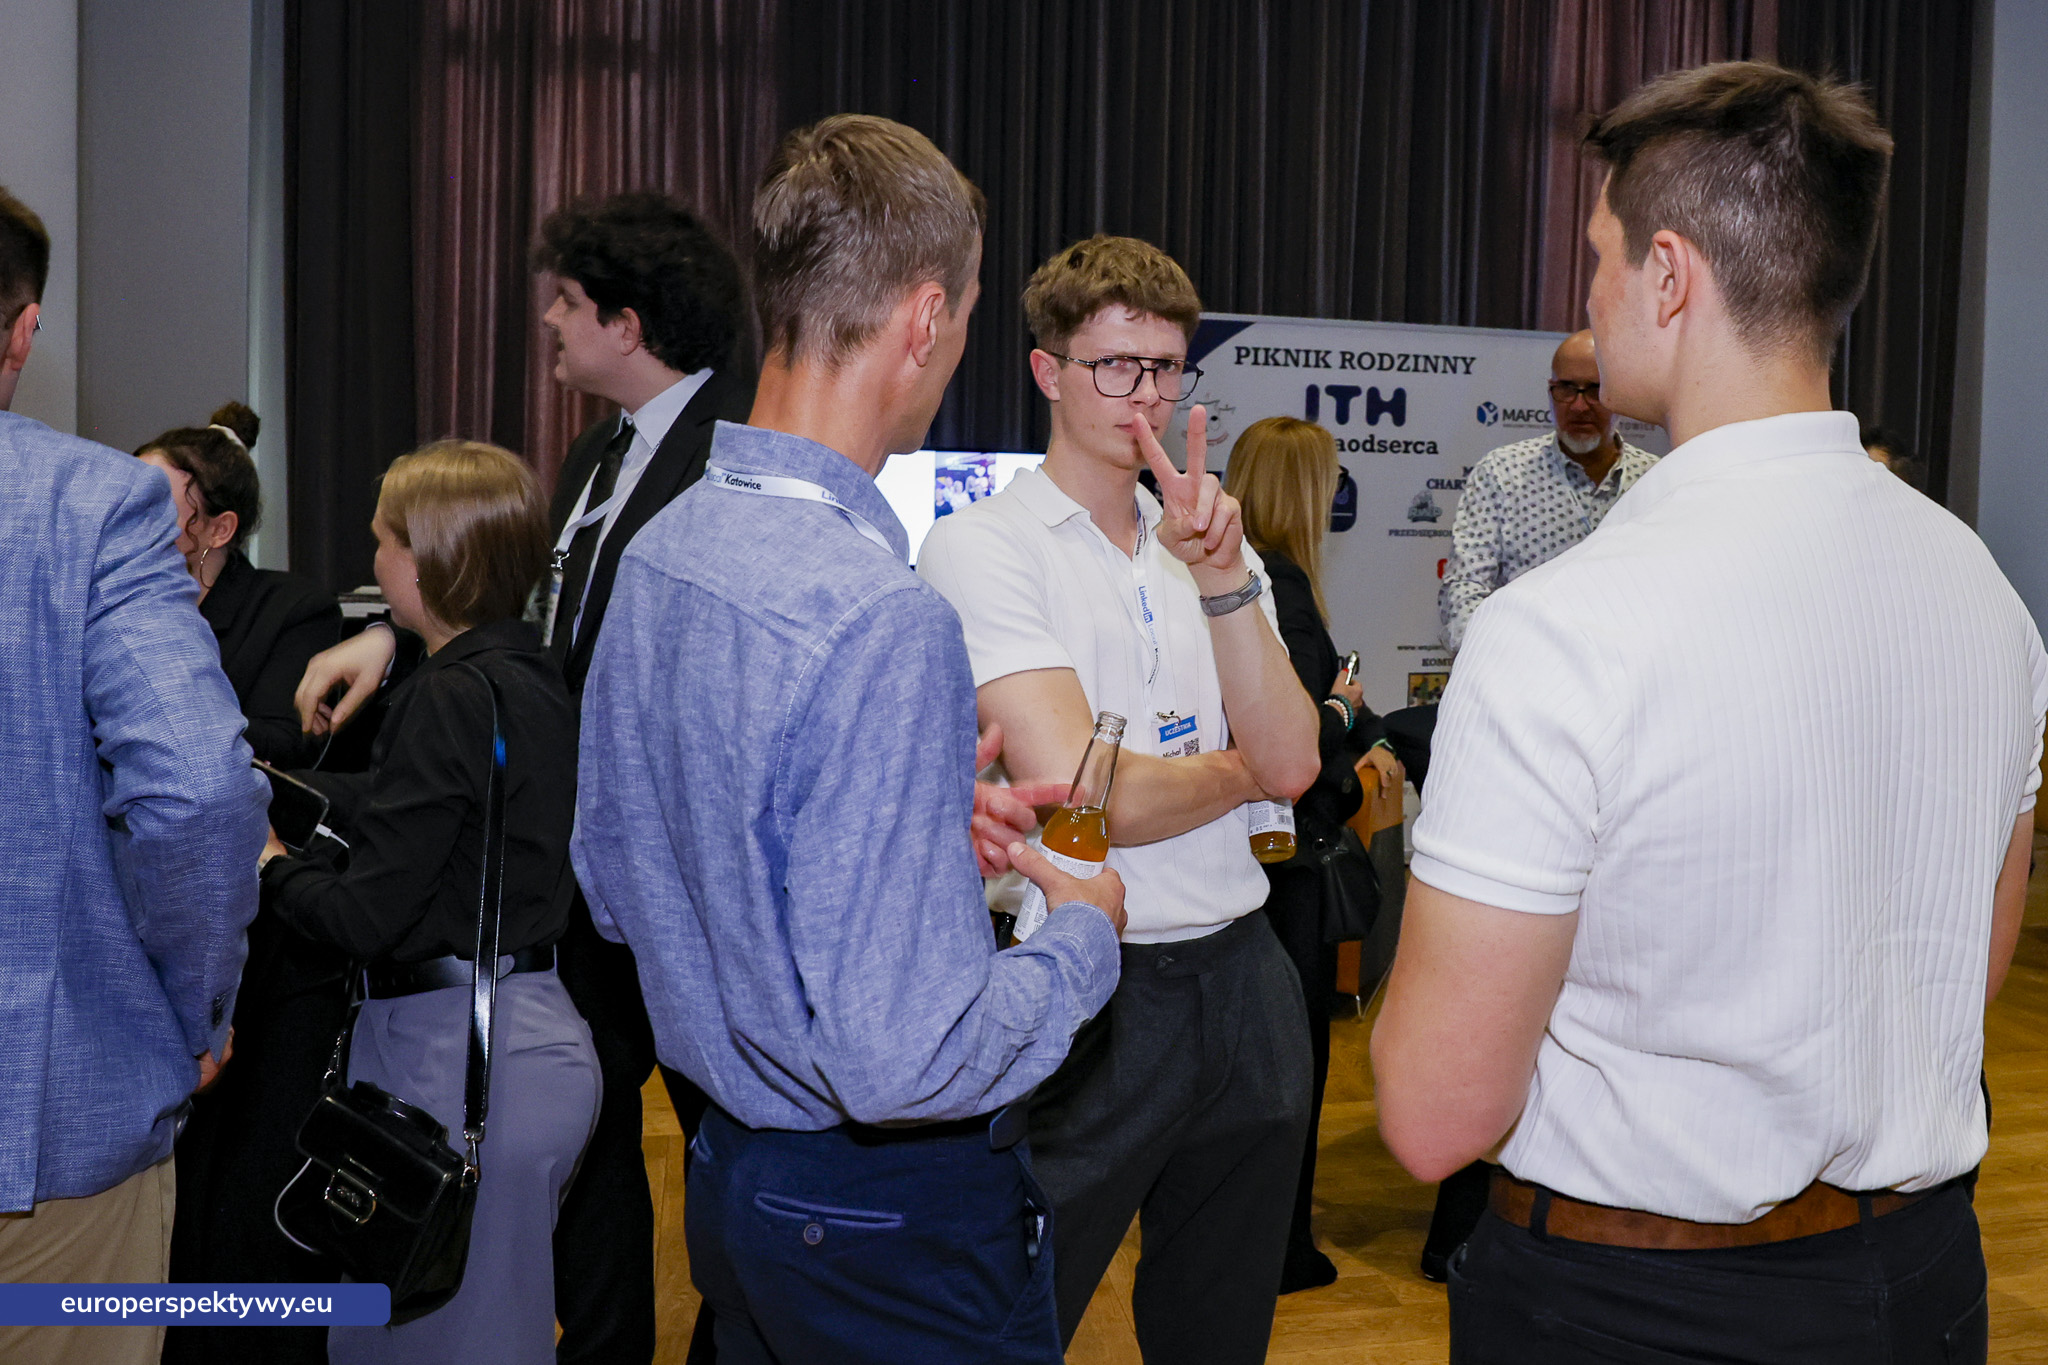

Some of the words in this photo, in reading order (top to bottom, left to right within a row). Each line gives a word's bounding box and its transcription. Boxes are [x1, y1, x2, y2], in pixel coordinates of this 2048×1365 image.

[1234, 346, 1332, 369] PIKNIK
[1339, 351, 1477, 375] RODZINNY
[1305, 383, 1407, 427] ITH
[724, 473, 762, 490] Katowice
